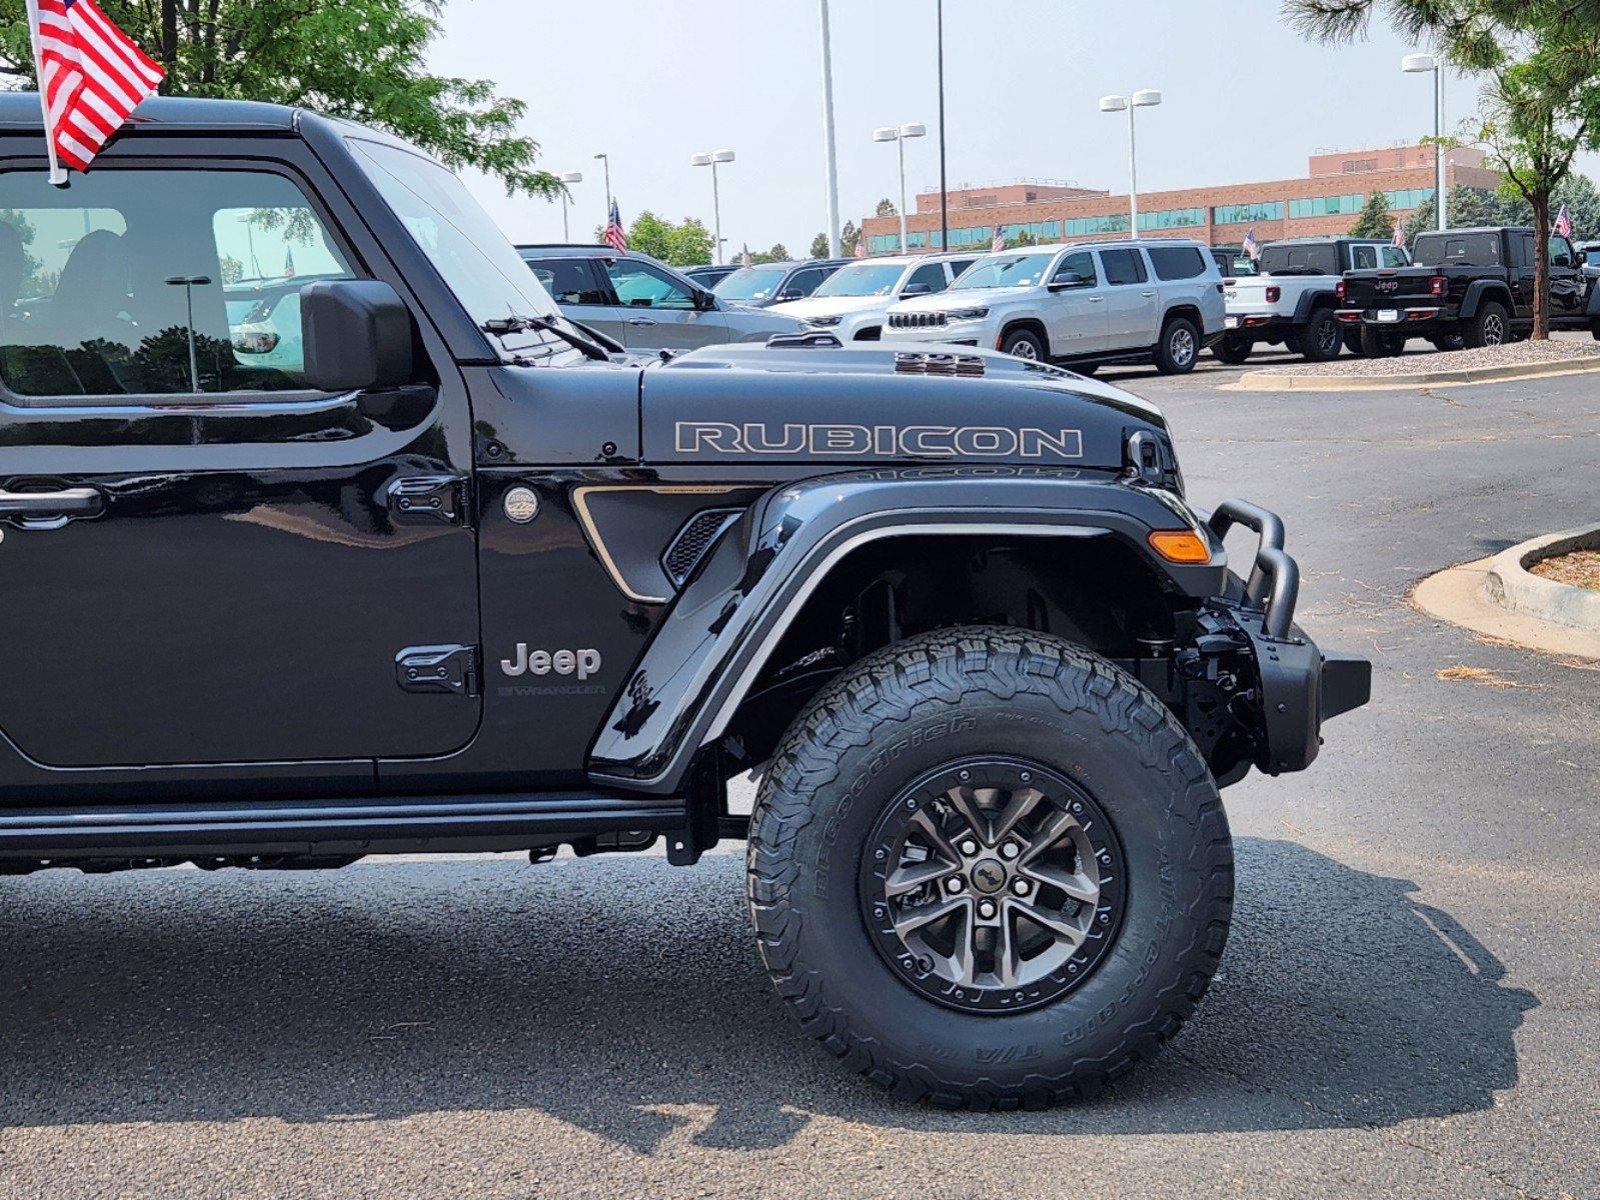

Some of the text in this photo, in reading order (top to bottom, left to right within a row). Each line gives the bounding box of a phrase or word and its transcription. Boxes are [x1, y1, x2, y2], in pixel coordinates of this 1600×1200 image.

[1374, 281, 1399, 291] Jeep
[674, 421, 1083, 458] RUBICON
[500, 642, 602, 680] Jeep
[513, 685, 607, 697] WRANGLER
